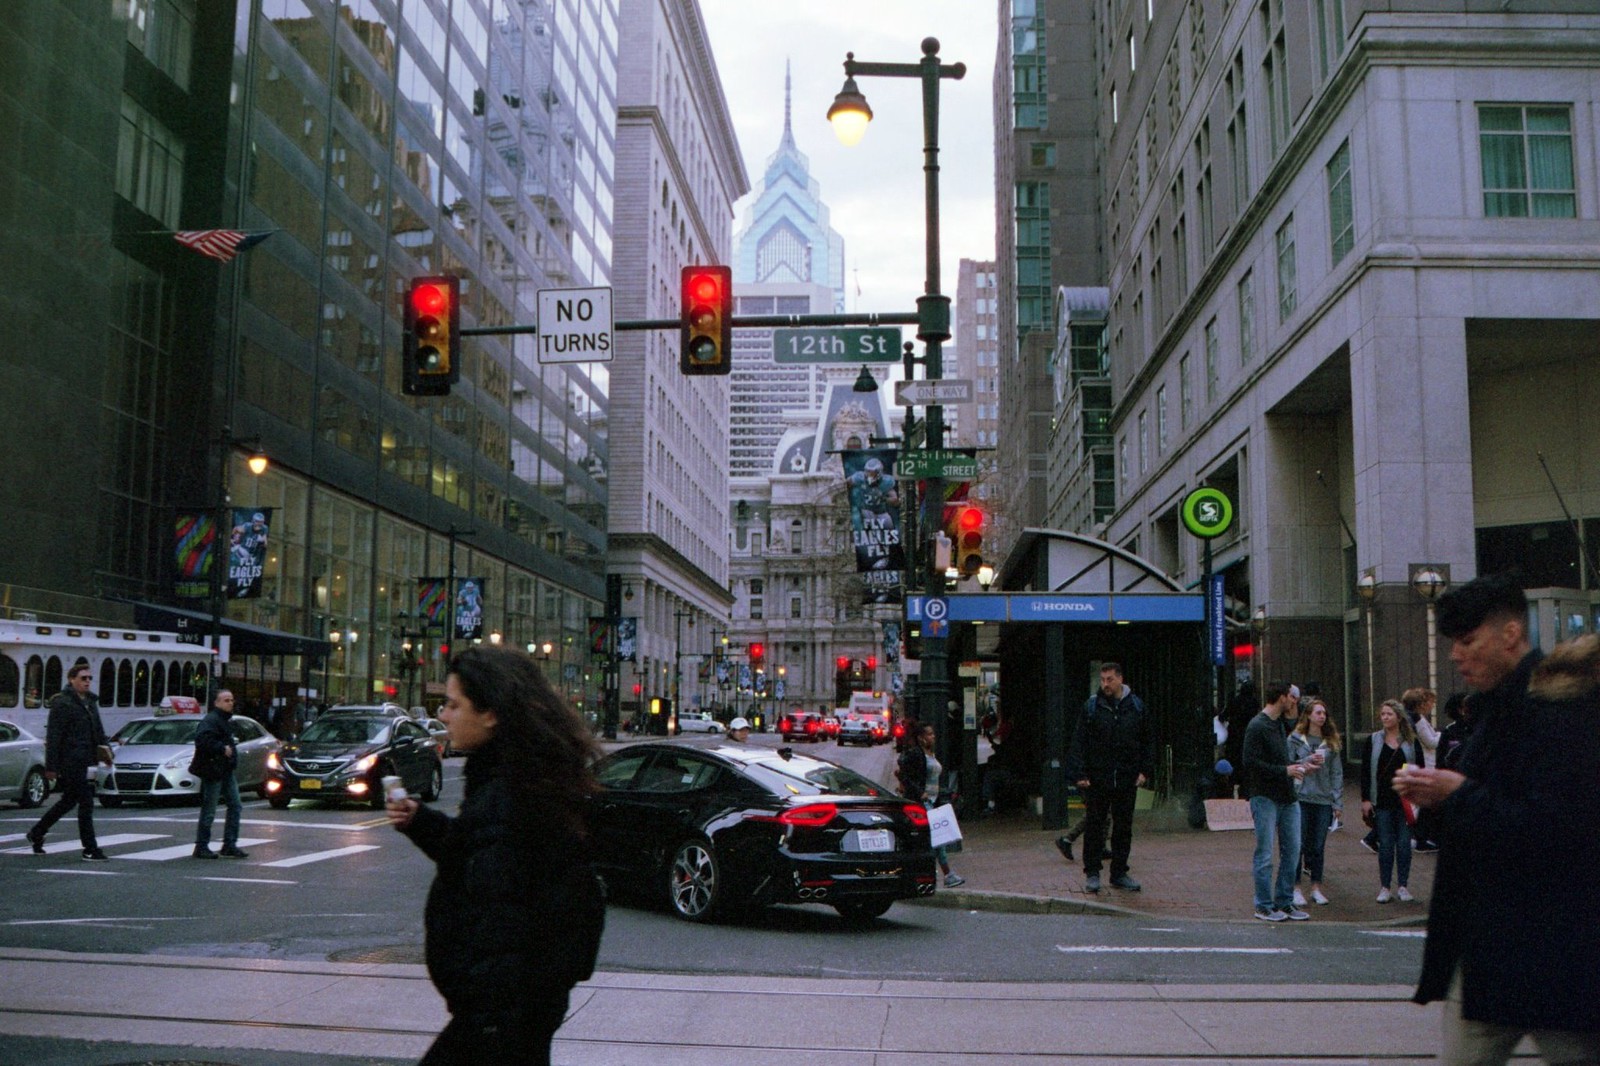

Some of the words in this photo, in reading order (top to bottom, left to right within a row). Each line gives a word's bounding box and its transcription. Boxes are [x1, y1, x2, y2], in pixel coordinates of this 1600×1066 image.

[557, 298, 593, 322] NO
[541, 332, 610, 352] TURNS
[789, 335, 845, 354] 12th
[859, 334, 887, 353] St
[917, 387, 937, 398] ONE
[943, 386, 964, 397] WAY
[942, 465, 975, 476] STREET
[863, 518, 886, 530] FLY
[853, 529, 900, 546] EAGLES
[867, 545, 890, 557] FLY
[229, 565, 262, 579] EAGLES
[237, 578, 253, 587] FLY
[1043, 602, 1094, 611] HONDA
[1215, 597, 1223, 628] Frankford
[1215, 629, 1223, 652] Market
